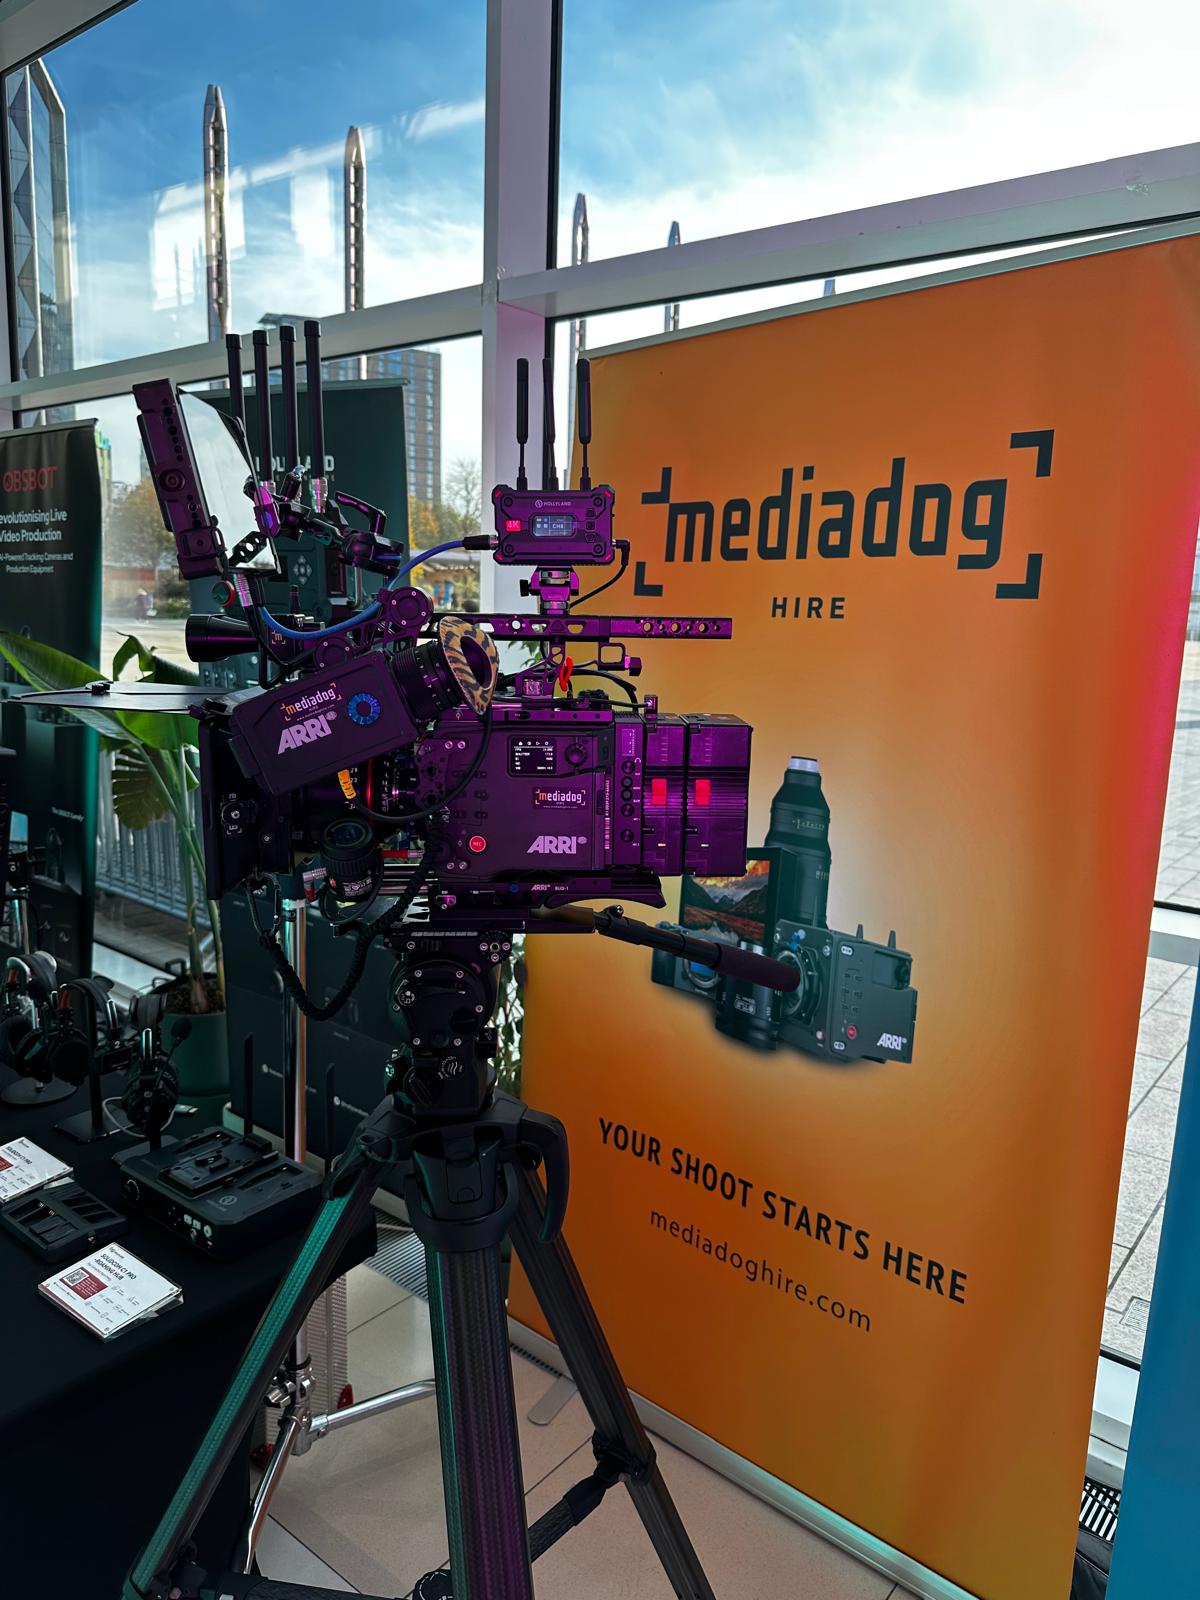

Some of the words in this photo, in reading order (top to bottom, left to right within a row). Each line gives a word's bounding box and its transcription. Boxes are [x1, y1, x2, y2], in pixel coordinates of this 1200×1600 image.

[3, 466, 57, 492] OBSBOT
[50, 508, 67, 521] Live
[507, 520, 519, 529] 4K
[664, 457, 1008, 570] mediadog
[21, 528, 62, 541] Production
[771, 596, 846, 619] HIRE
[284, 688, 337, 715] mediadog
[278, 714, 332, 755] ARRI
[538, 790, 582, 803] mediadog
[526, 835, 577, 854] ARRI
[877, 1033, 901, 1051] ARRI
[599, 1117, 661, 1166] YOUR
[671, 1148, 753, 1208] SHOOT
[762, 1190, 870, 1260] STARTS
[882, 1241, 968, 1304] HERE
[650, 1210, 871, 1332] mediadoghire.com
